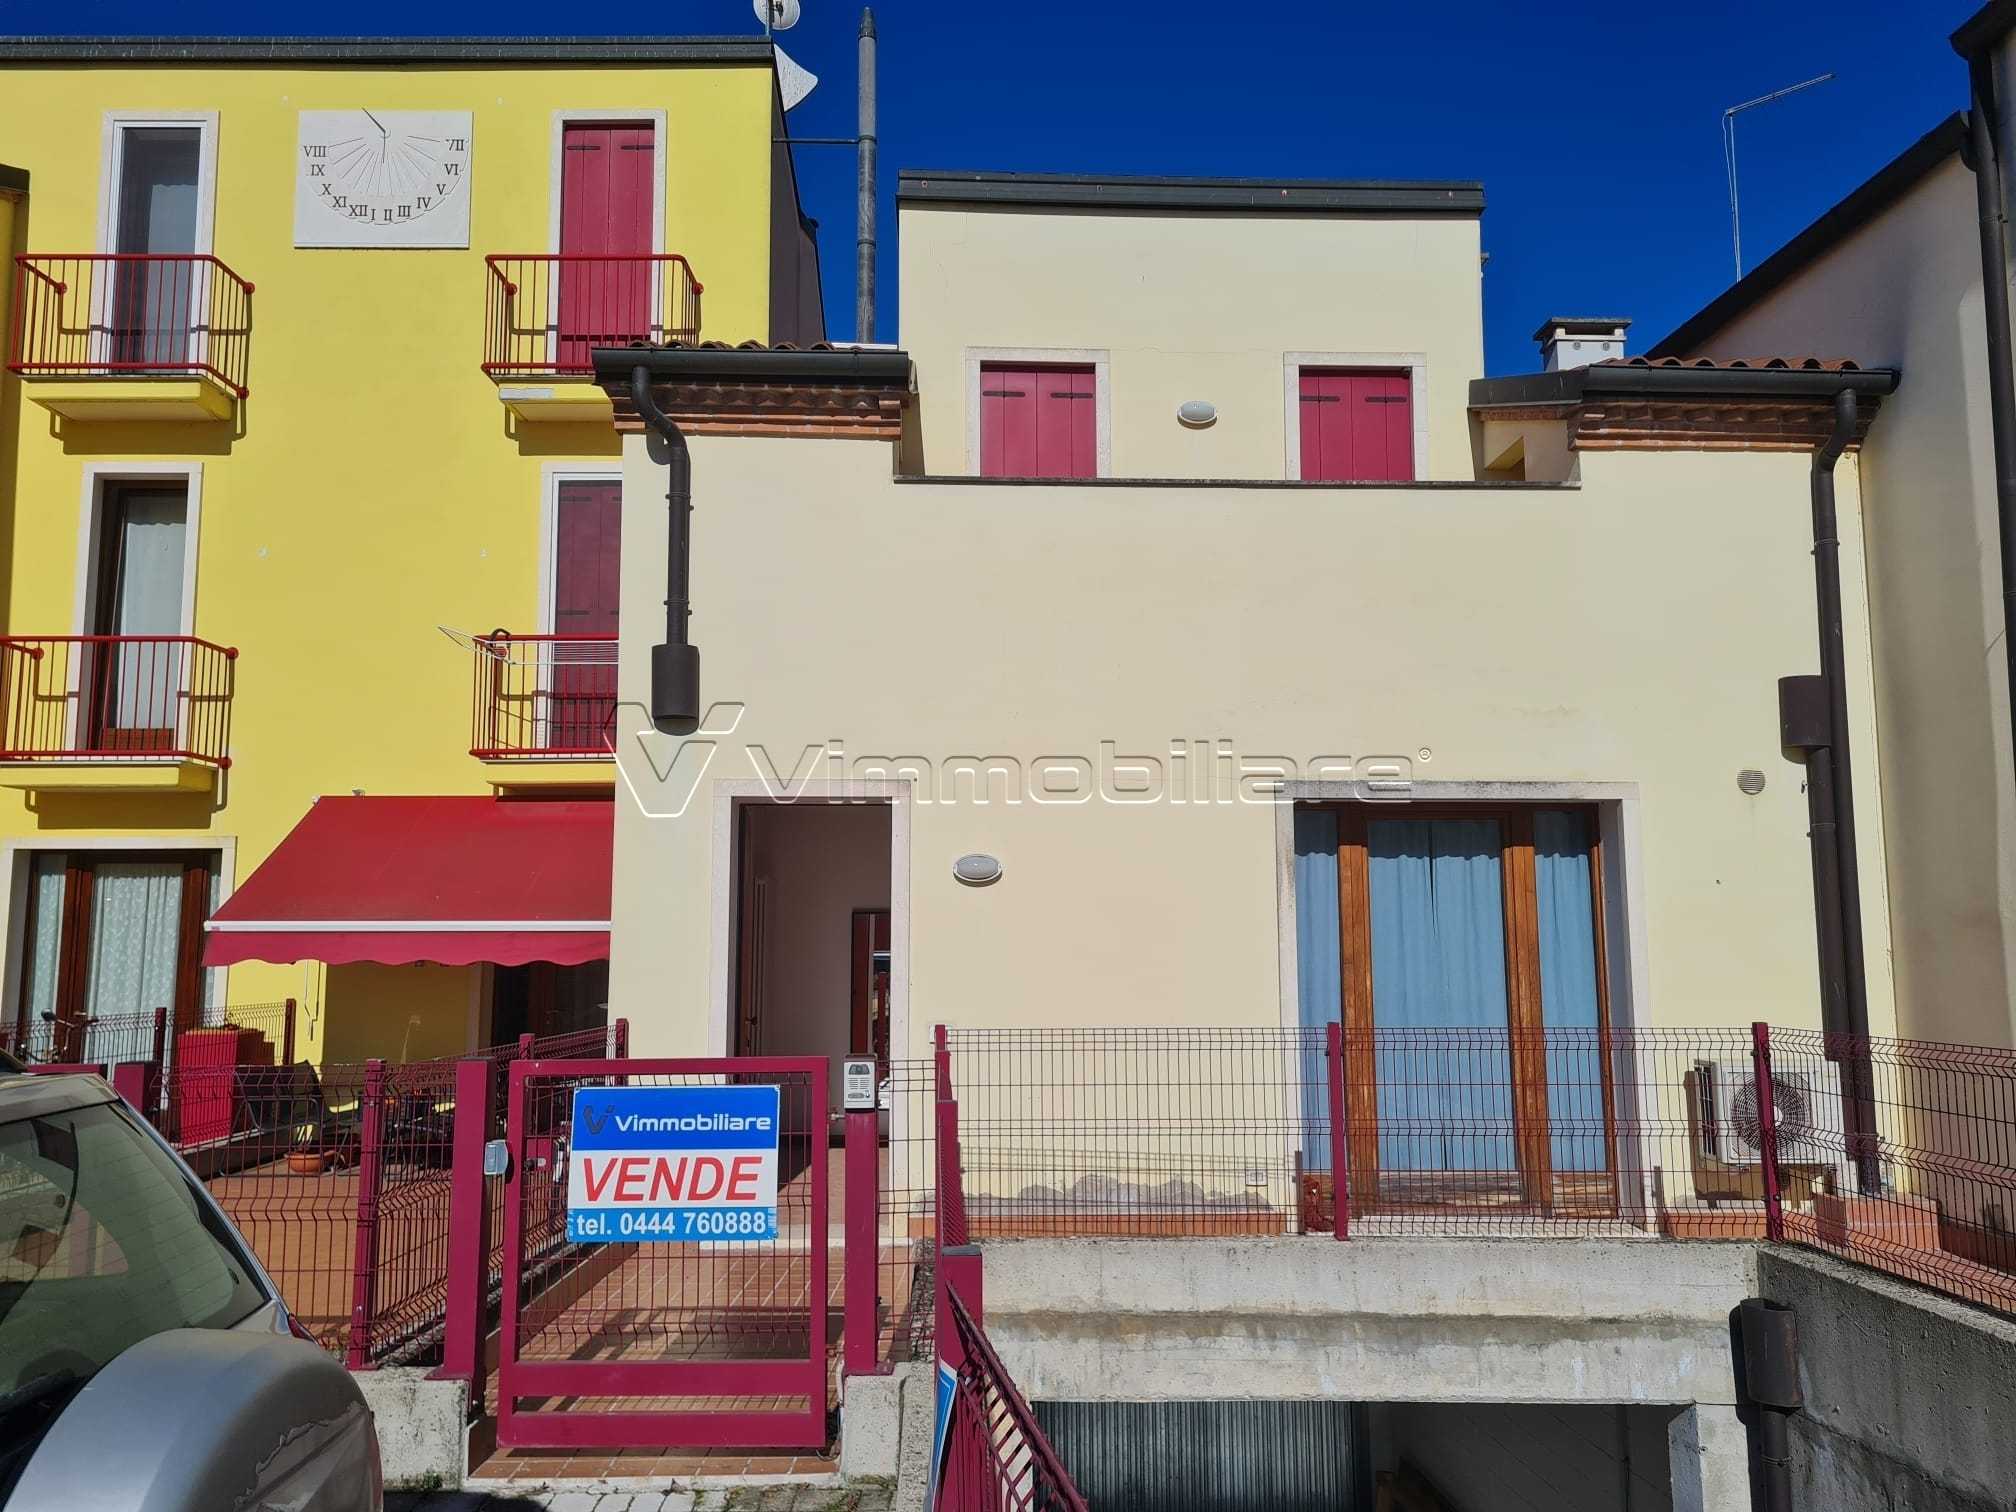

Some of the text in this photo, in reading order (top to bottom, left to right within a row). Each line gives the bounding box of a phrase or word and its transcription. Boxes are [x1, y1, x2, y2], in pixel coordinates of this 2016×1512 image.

[304, 145, 327, 158] VIII
[311, 164, 325, 176] IX
[444, 163, 459, 176] VI
[322, 184, 332, 195] X
[436, 184, 446, 195] V
[333, 196, 347, 208] XI
[417, 197, 431, 209] IV
[349, 205, 368, 217] XII
[371, 208, 376, 221] I
[384, 208, 393, 221] II
[398, 205, 411, 217] III
[615, 1113, 771, 1132] Vimmobiliare
[583, 1156, 763, 1201] VENDE
[576, 1212, 612, 1235] tel.
[620, 1212, 675, 1234] 0444
[683, 1211, 767, 1234] 760888
